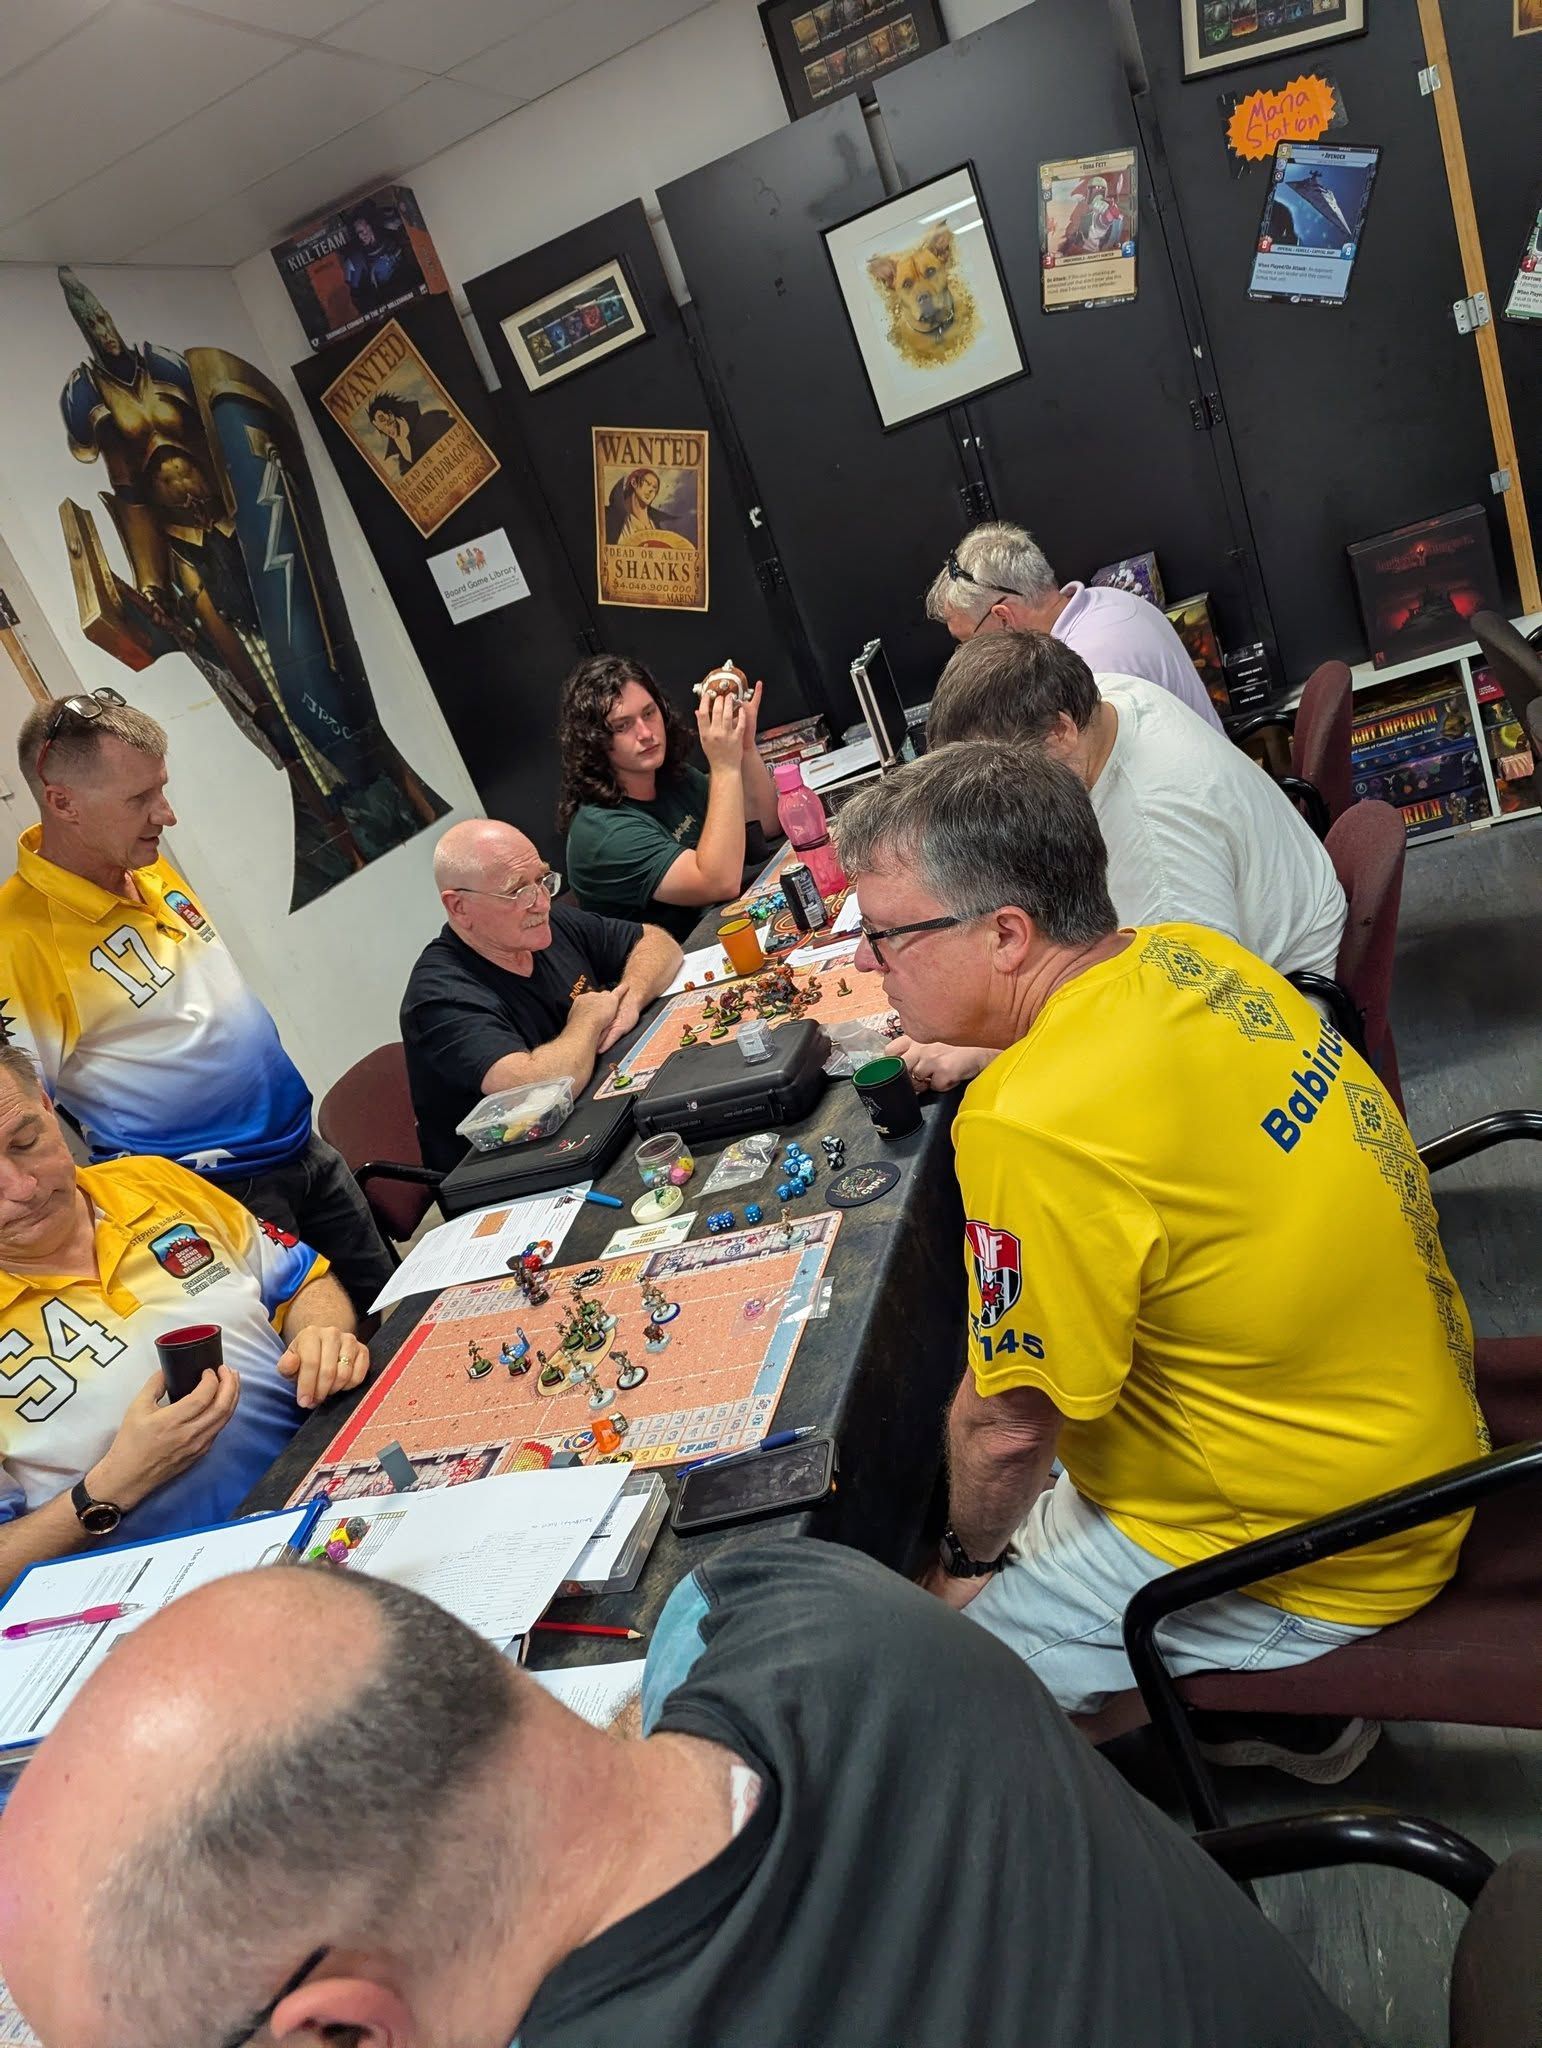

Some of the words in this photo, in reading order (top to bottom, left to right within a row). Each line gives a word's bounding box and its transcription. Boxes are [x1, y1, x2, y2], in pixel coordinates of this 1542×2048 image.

[1246, 111, 1320, 148] Station
[287, 249, 315, 272] KILL
[312, 232, 347, 258] TEAM
[328, 332, 407, 416] WANTED
[600, 435, 700, 466] WANTED
[401, 469, 421, 493] DEAD
[609, 547, 635, 558] DEAD
[641, 550, 654, 560] OR
[661, 551, 693, 562] ALIVE
[444, 584, 467, 599] Board
[467, 576, 489, 590] Game
[489, 565, 518, 581] Library
[615, 559, 690, 583] SHANKS
[1380, 707, 1438, 736] IMPERIUM
[1402, 801, 1442, 825] RIUM
[90, 924, 175, 1008] 17
[130, 1225, 160, 1247] STEPHEN
[646, 1434, 658, 1445] 2
[667, 1430, 678, 1441] 3
[731, 1419, 742, 1430] 6
[654, 1418, 665, 1428] 2
[674, 1414, 686, 1425] 3
[695, 1411, 706, 1422] 4
[638, 1450, 650, 1461] 2
